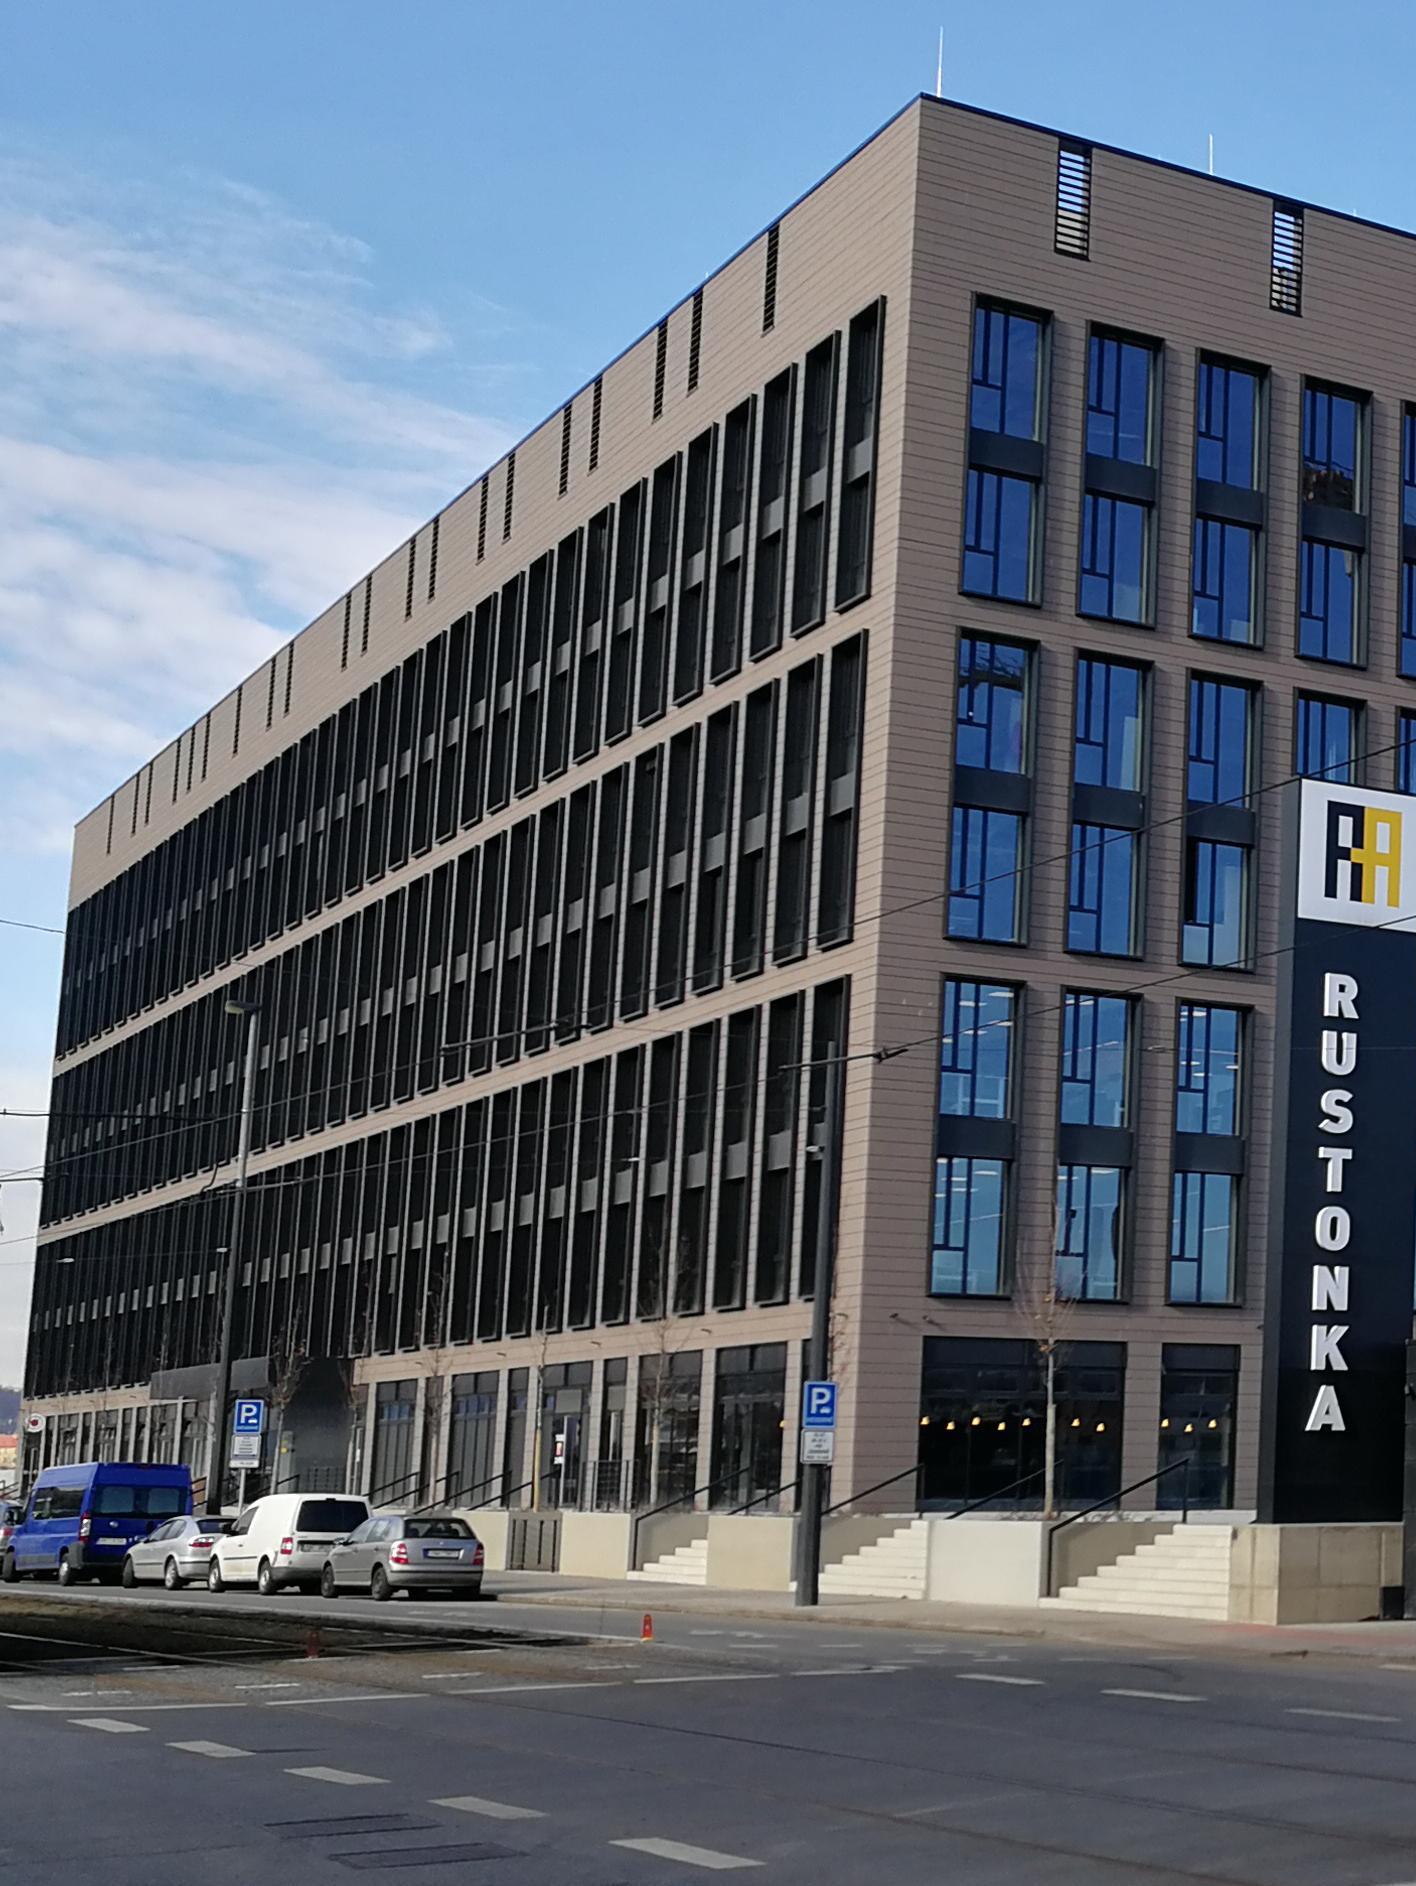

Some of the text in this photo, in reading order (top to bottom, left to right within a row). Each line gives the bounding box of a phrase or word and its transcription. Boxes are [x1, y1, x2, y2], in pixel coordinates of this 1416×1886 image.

[1305, 972, 1359, 1431] RUSTONKA
[240, 1404, 257, 1424] P
[810, 1387, 832, 1414] P
